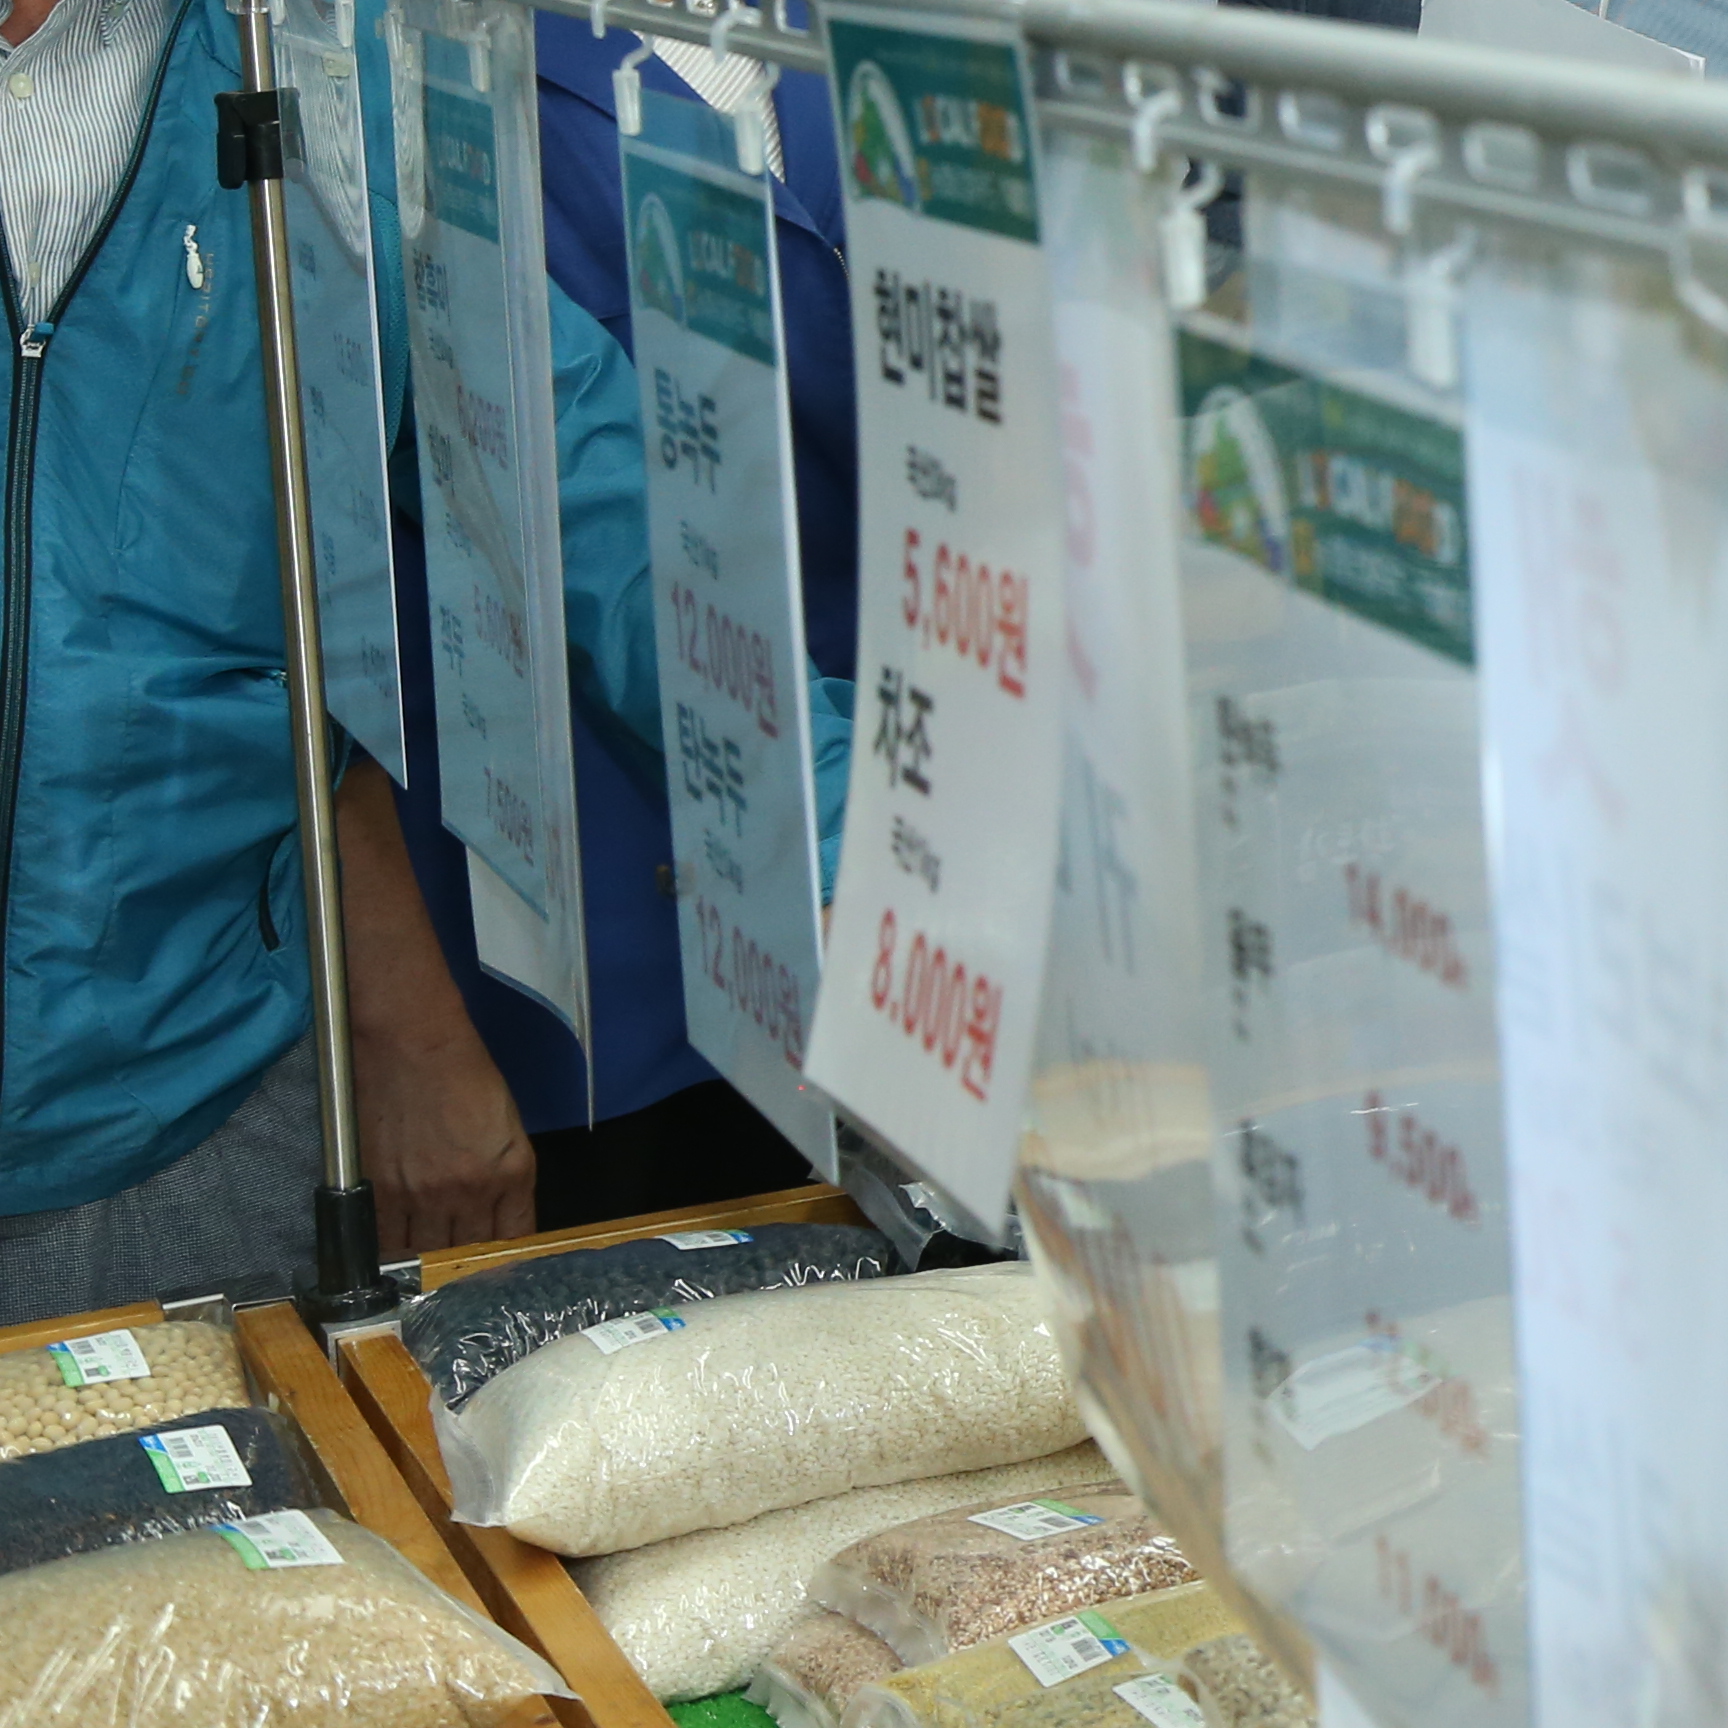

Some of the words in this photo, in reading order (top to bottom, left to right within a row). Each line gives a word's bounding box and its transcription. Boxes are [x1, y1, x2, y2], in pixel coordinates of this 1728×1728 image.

[873, 264, 1004, 427] 현미찹쌀
[669, 578, 780, 740] 12,000원
[900, 526, 1032, 701] 5,600원
[871, 663, 936, 798] 차조
[694, 893, 806, 1074] 12,000원
